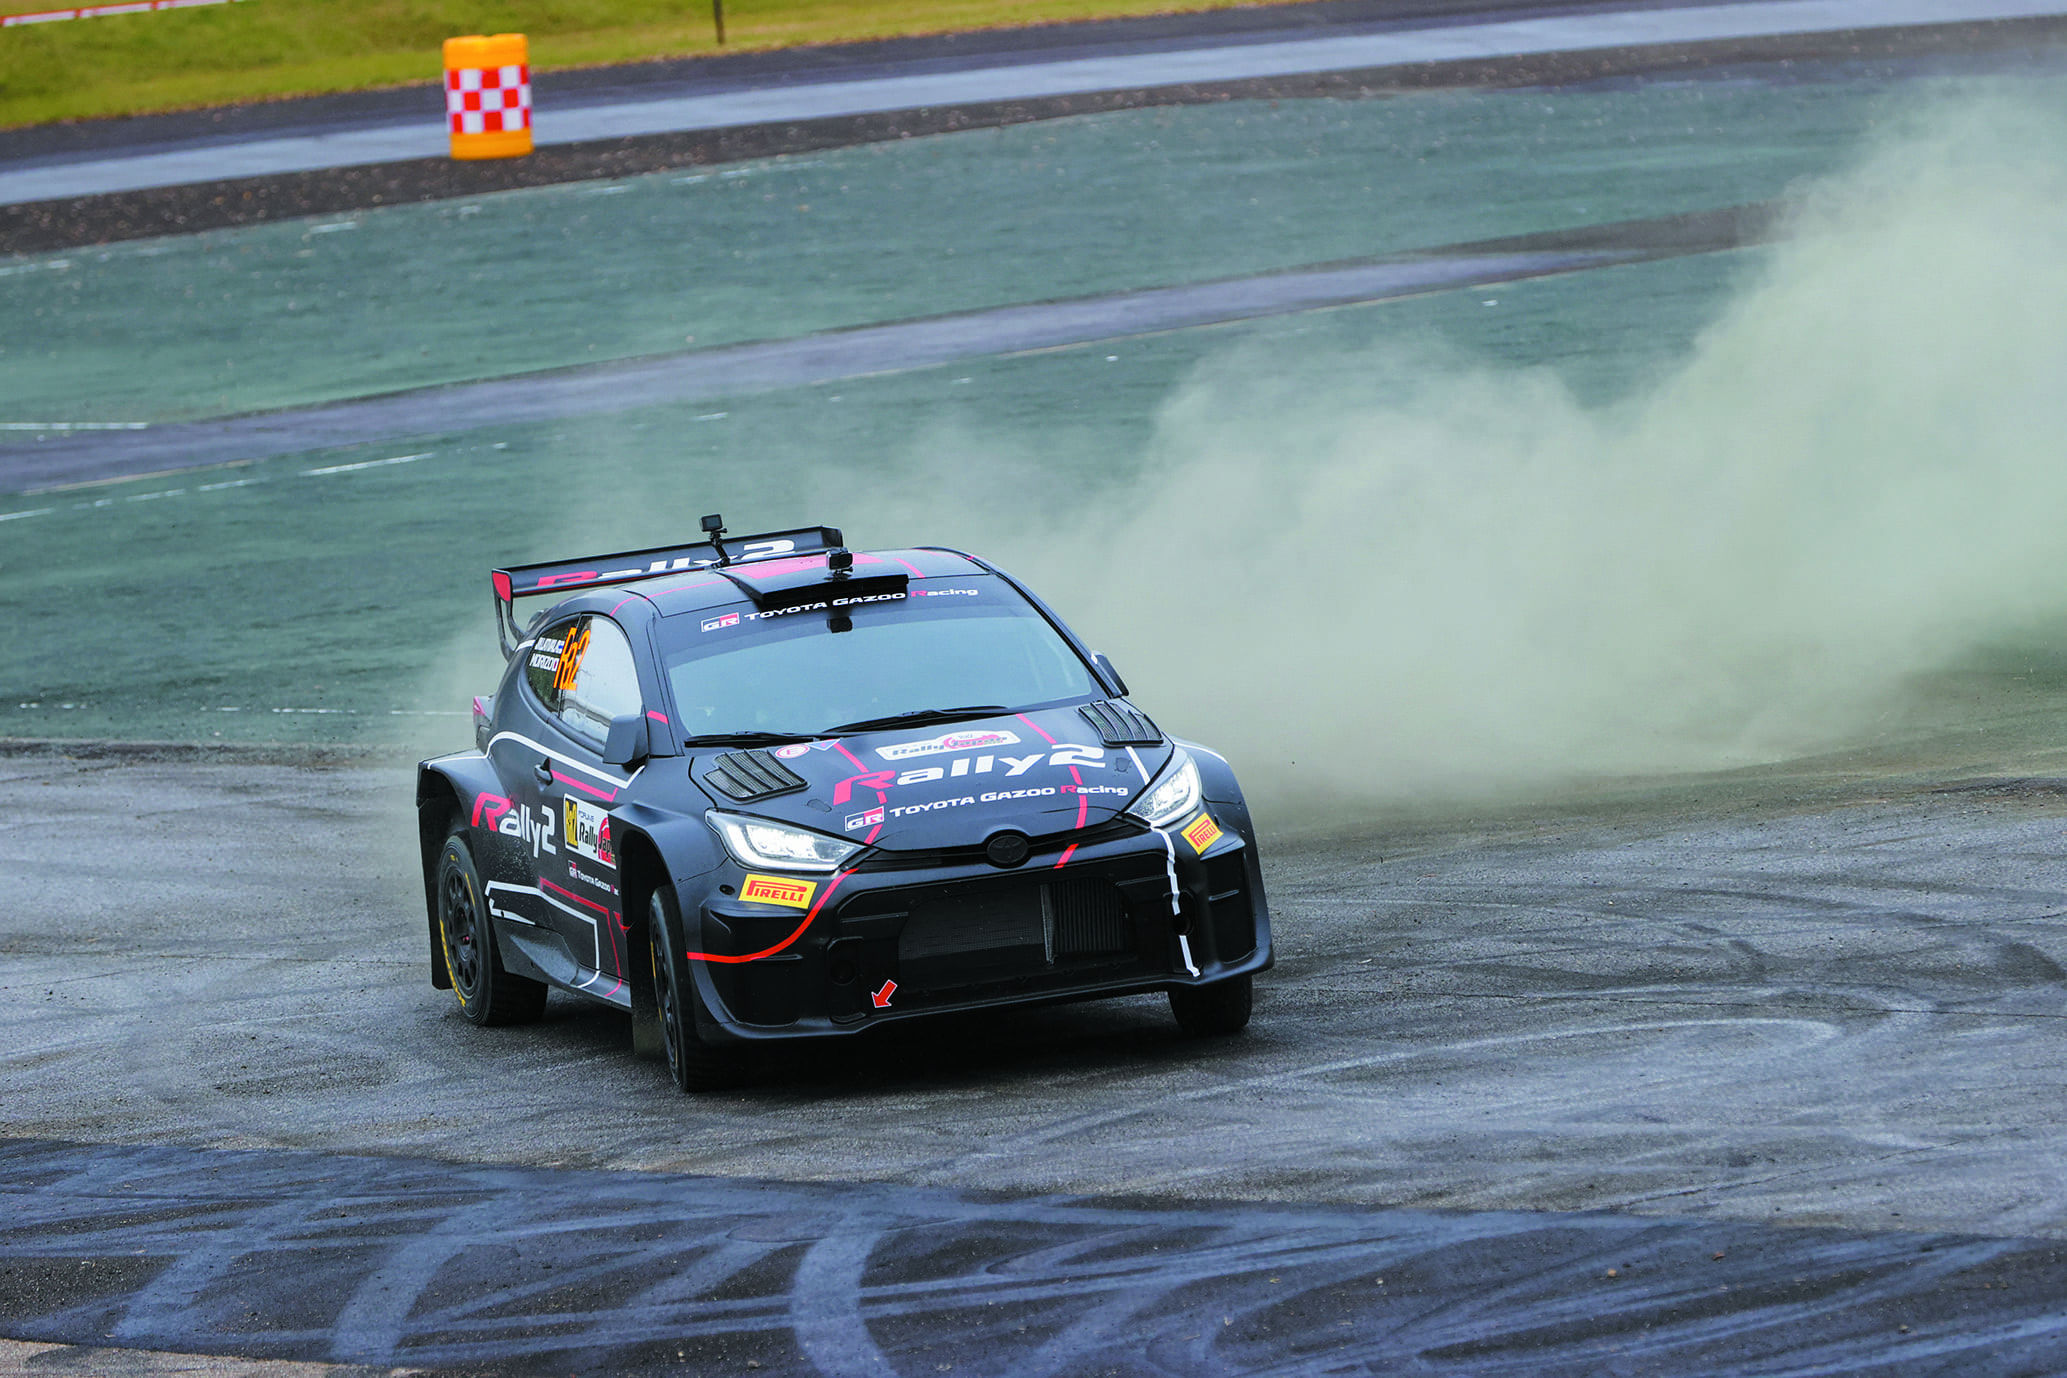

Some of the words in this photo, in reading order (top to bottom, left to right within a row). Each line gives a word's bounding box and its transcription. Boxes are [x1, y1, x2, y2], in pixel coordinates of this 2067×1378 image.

[702, 614, 739, 631] GR
[744, 601, 828, 621] TOYOTA
[832, 592, 906, 607] GAZOO
[911, 587, 979, 597] Racing
[893, 744, 944, 756] Rally
[833, 744, 1106, 806] Rally2
[471, 791, 557, 858] Rally2
[846, 808, 884, 830] GR
[889, 796, 976, 818] TOYOTA
[980, 786, 1056, 803] GAZOO
[1060, 784, 1129, 796] Racing
[579, 821, 598, 854] Rally
[598, 830, 613, 858] Jap
[1188, 819, 1218, 847] PIRELLI
[576, 870, 595, 885] TOYOTA
[746, 880, 808, 902] PIRELLI
